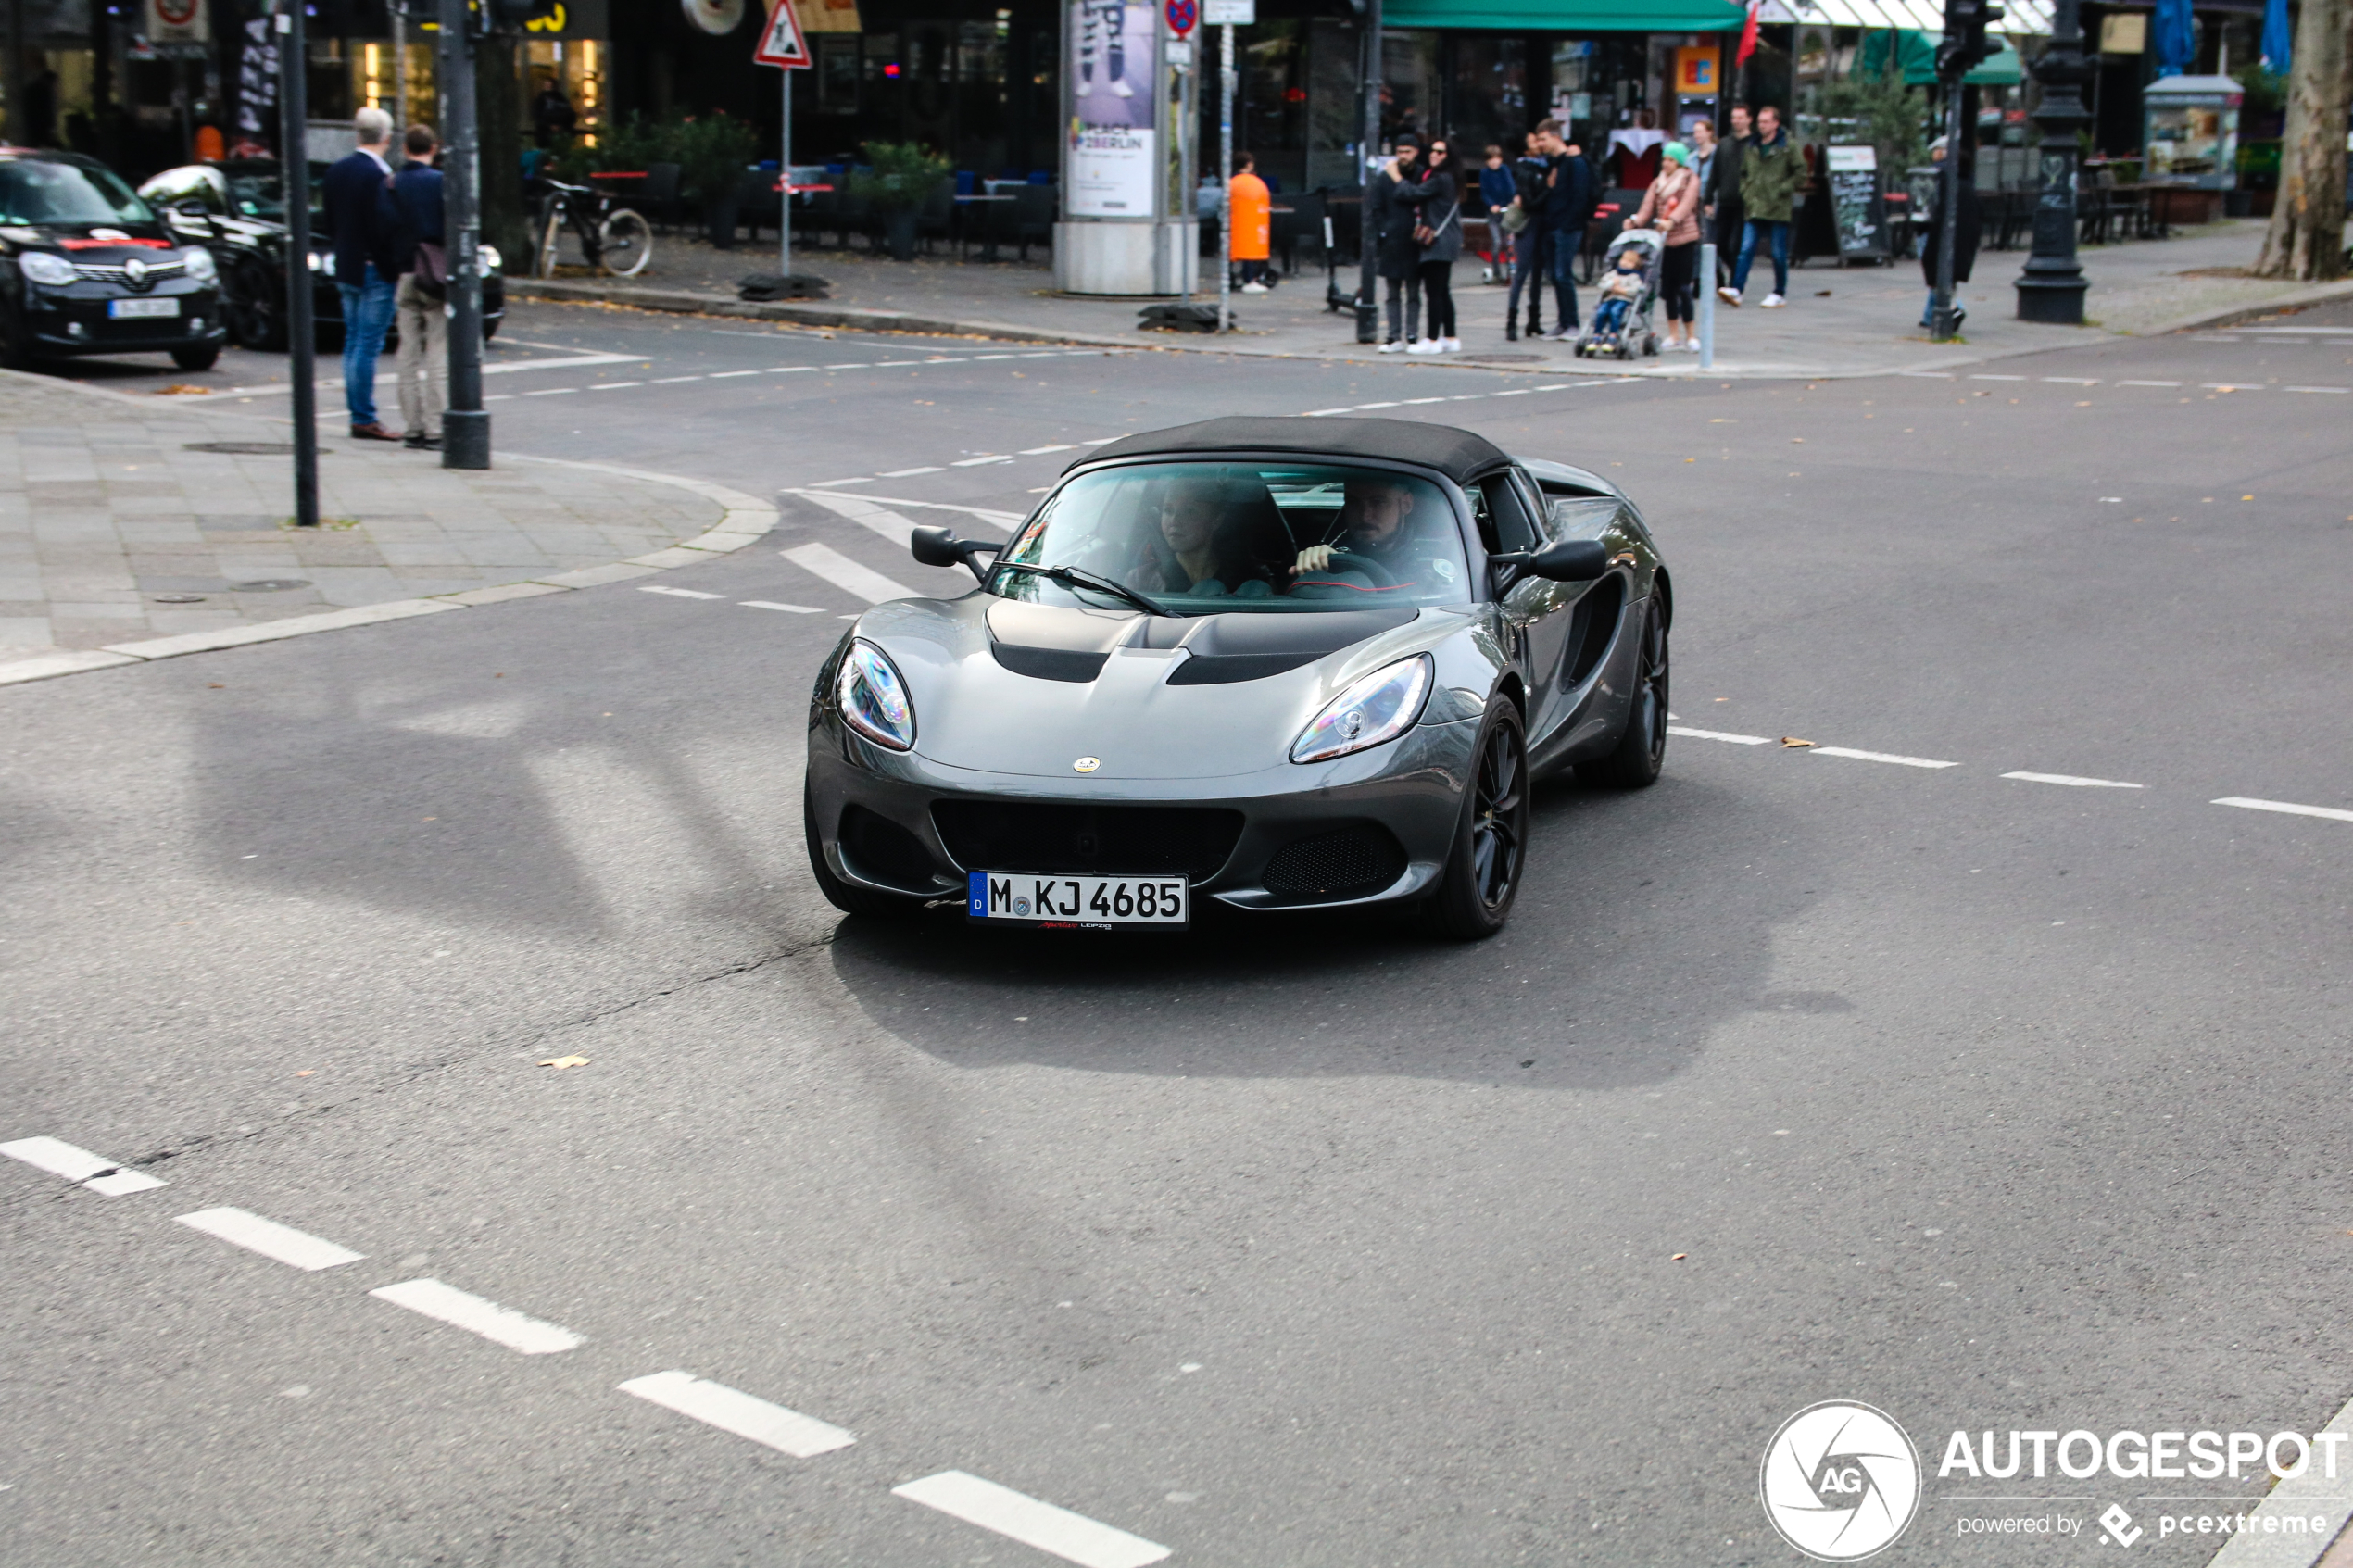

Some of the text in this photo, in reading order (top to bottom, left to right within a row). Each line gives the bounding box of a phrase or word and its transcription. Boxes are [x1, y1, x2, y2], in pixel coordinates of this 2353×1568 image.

[975, 899, 982, 909] D
[990, 878, 1181, 918] M KJ 4685
